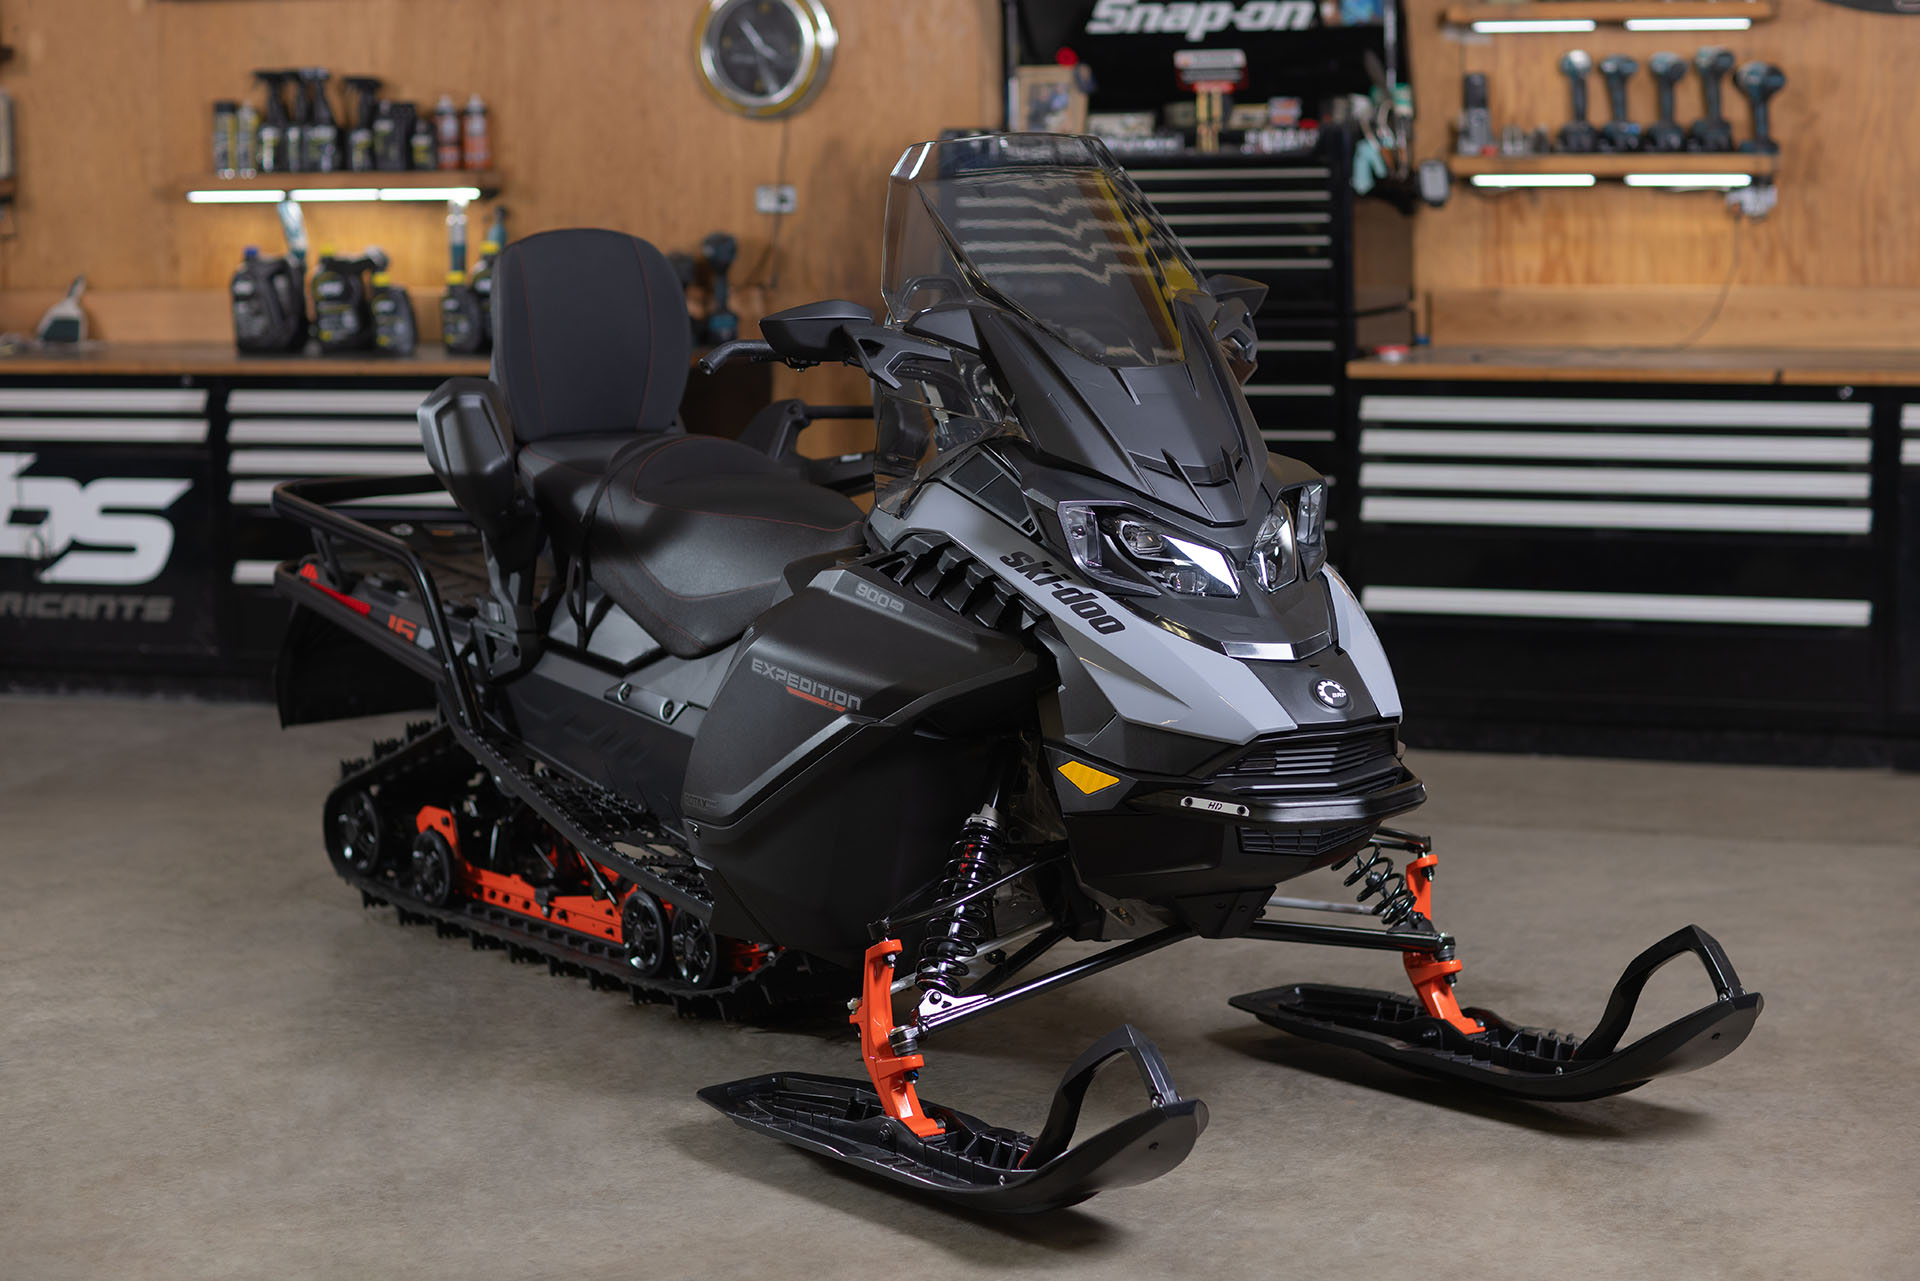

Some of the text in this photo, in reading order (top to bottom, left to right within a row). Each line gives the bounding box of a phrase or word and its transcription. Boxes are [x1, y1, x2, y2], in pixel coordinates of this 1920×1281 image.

[1086, 0, 1315, 42] Snap-on
[856, 583, 889, 608] 900
[1000, 551, 1126, 635] ski-doo
[751, 658, 861, 711] EXPEDITION
[1207, 802, 1223, 810] HD
